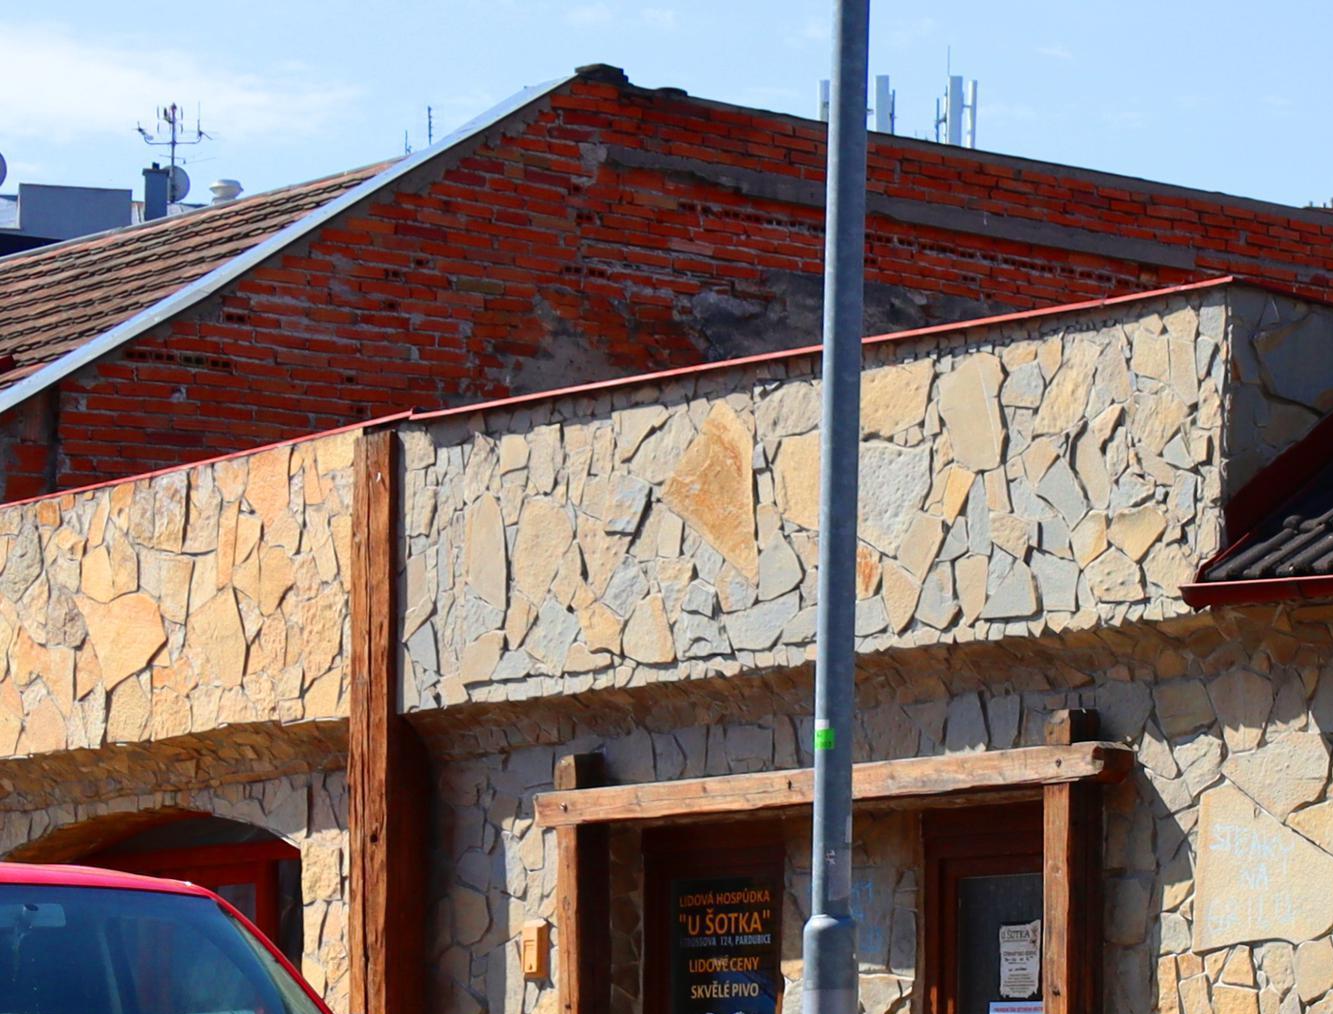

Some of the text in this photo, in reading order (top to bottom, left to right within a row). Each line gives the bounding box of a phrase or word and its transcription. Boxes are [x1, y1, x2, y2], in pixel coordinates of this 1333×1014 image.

[729, 956, 760, 972] CENY
[690, 979, 759, 999] SKVĚLÉ PIVO
